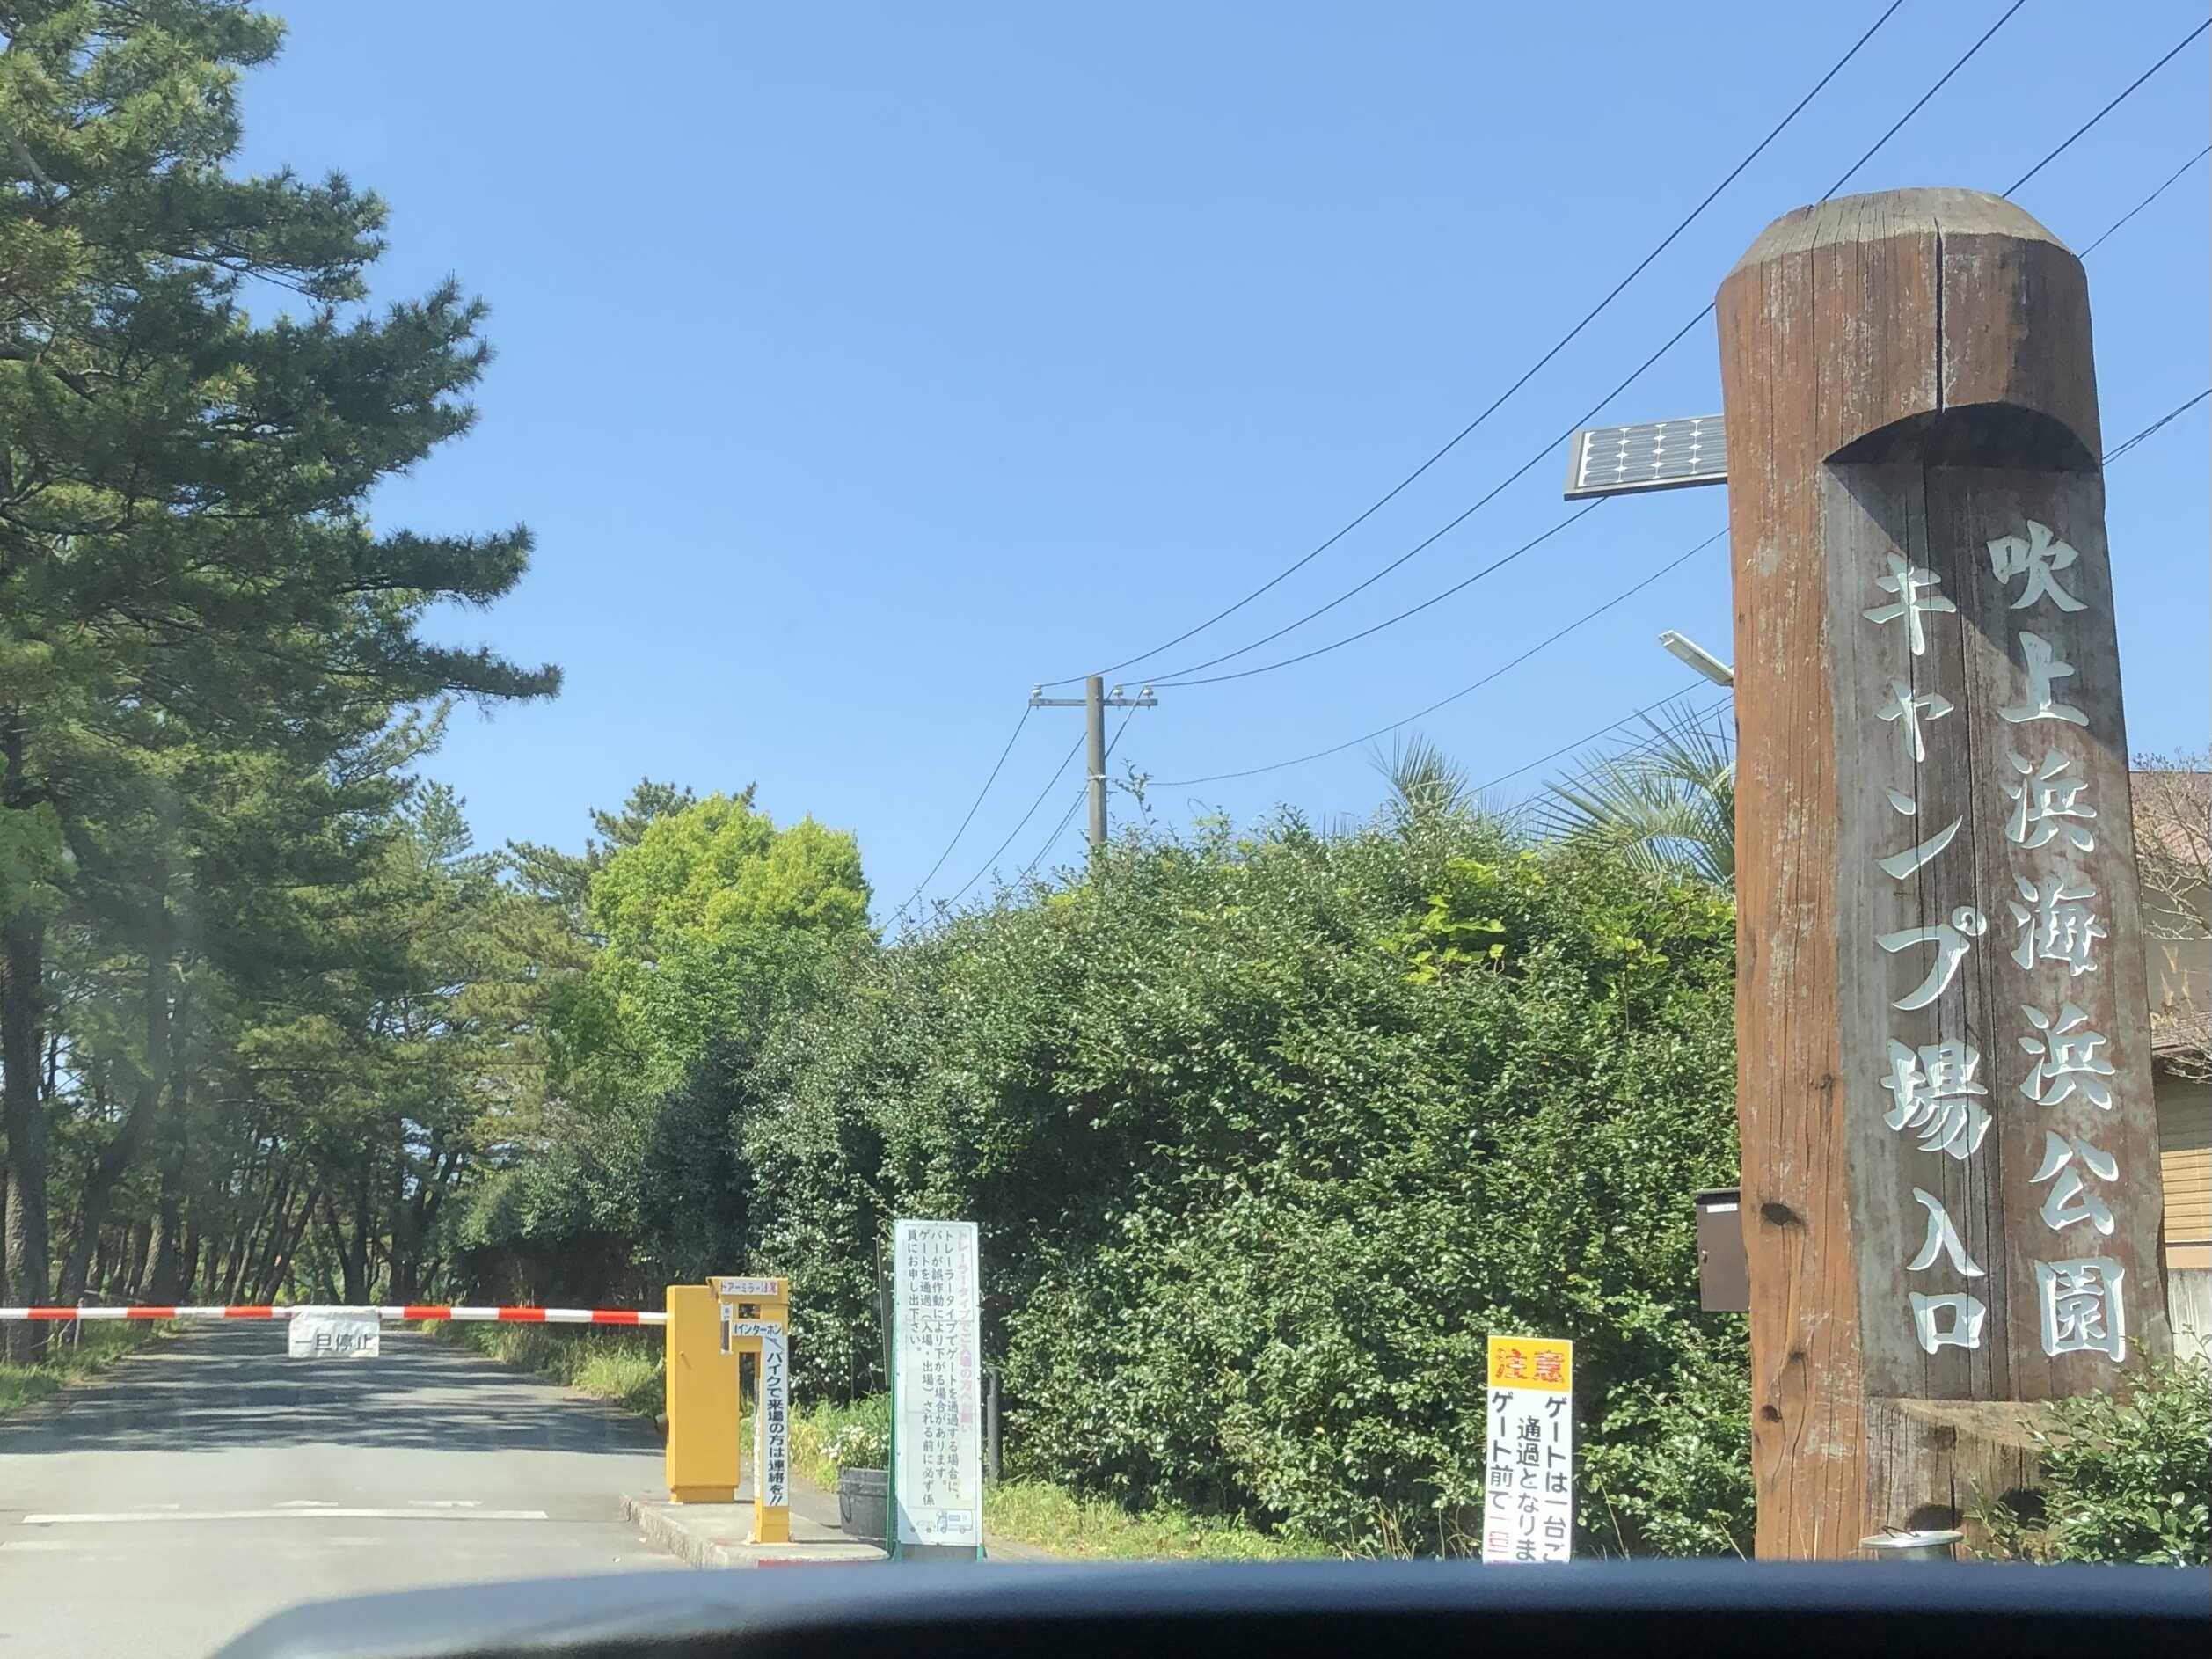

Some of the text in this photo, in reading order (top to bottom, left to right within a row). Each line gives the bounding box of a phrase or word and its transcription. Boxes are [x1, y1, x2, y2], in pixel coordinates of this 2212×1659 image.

[1863, 552, 1993, 1355] キャンプ場入口
[1987, 518, 2125, 1363] 吹上浜海浜公園
[295, 1333, 373, 1352] 一旦停止
[1495, 1348, 1566, 1384] 注意
